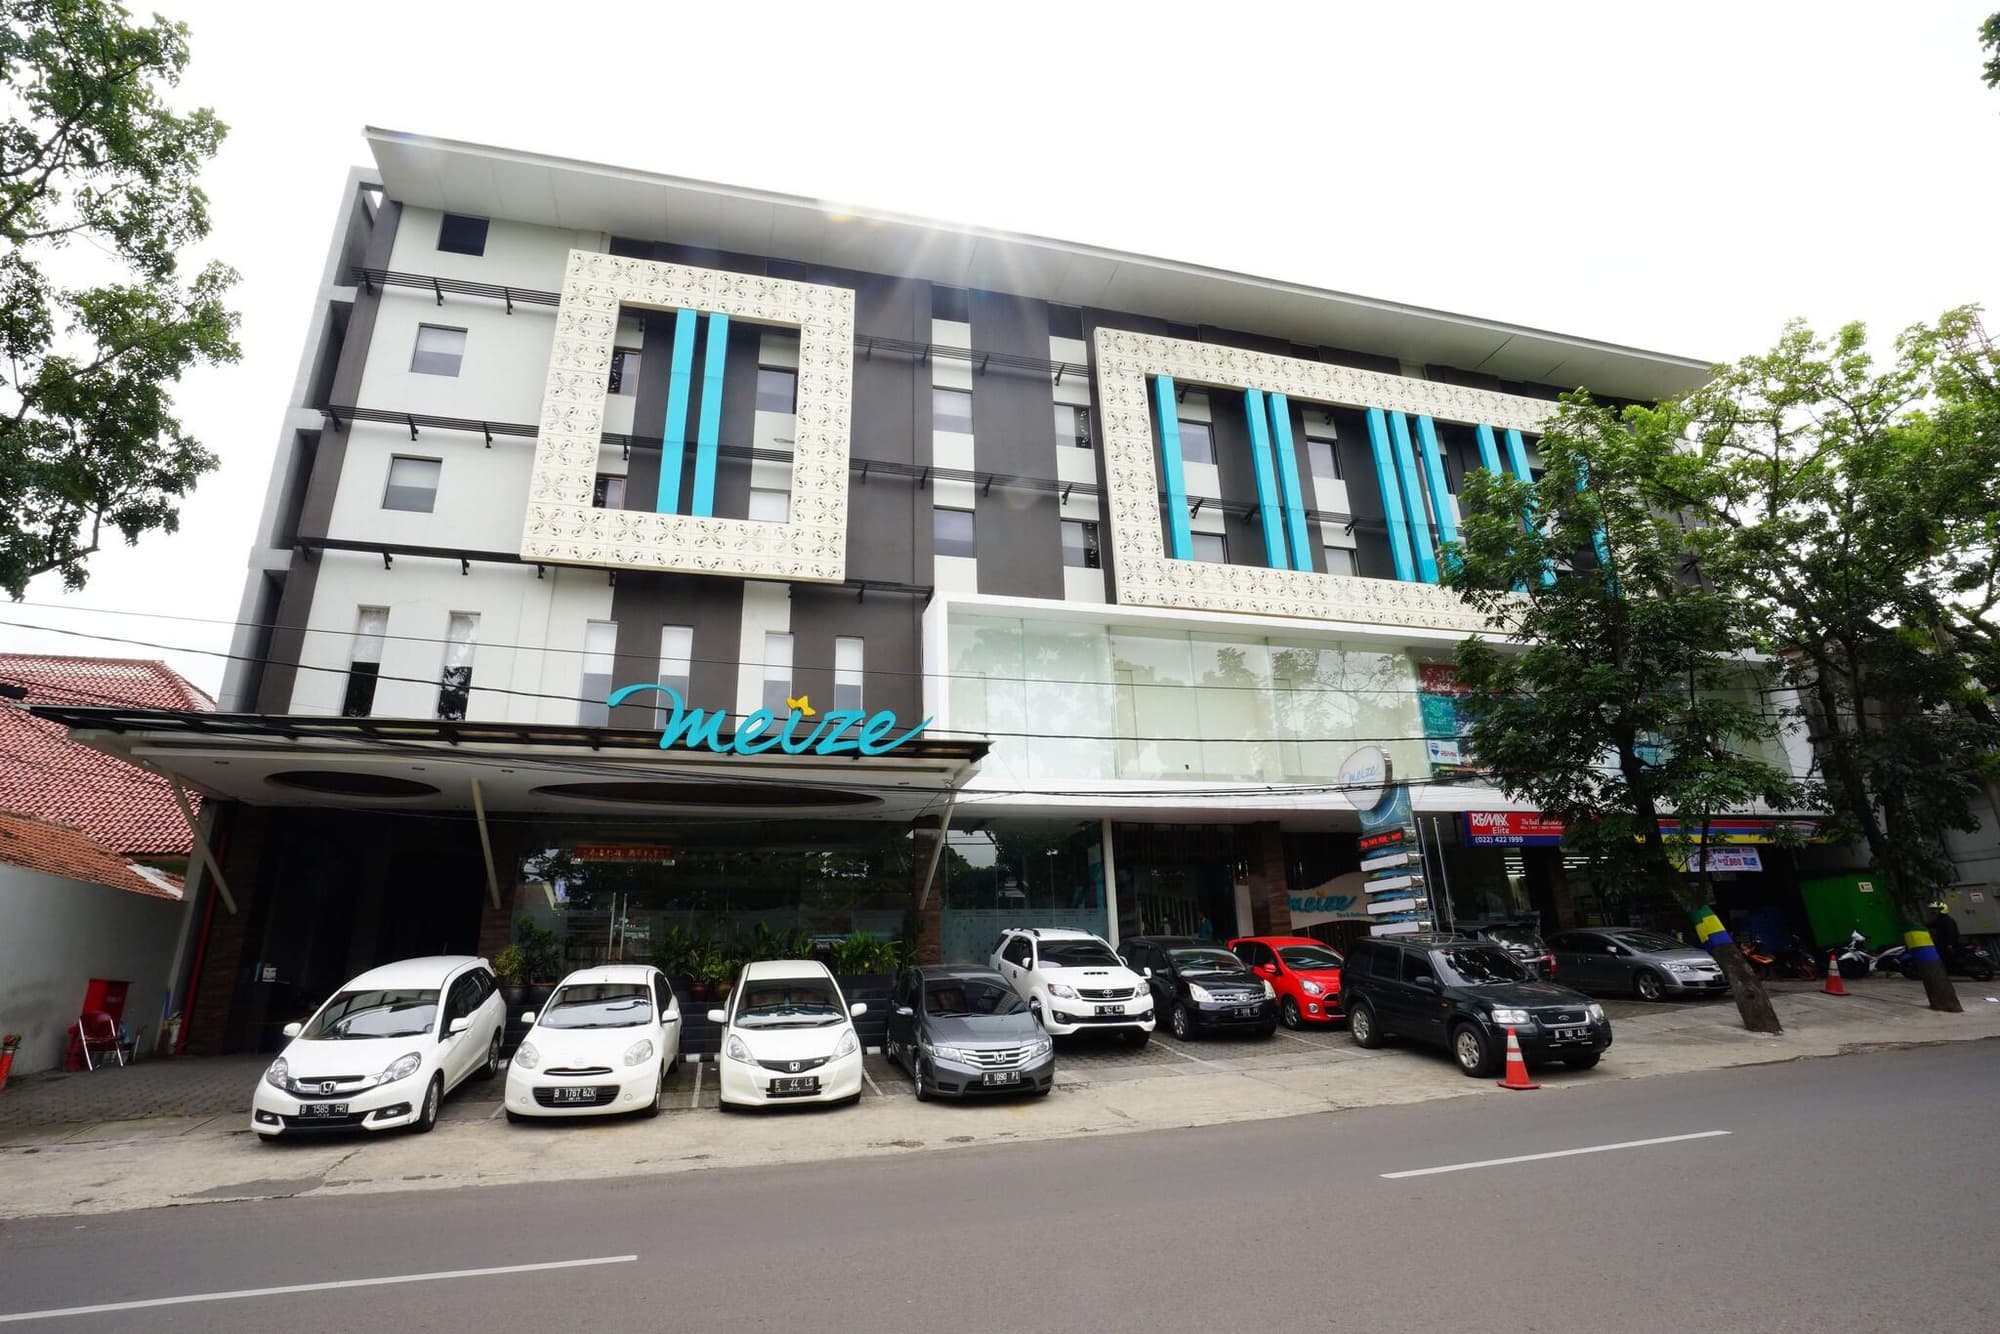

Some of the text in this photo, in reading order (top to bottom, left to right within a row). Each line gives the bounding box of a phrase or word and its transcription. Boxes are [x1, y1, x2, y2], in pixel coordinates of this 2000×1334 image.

[607, 684, 933, 755] meize
[1471, 813, 1509, 827] RE/MAX
[1492, 827, 1510, 835] Elite
[1474, 836, 1493, 844] (022)
